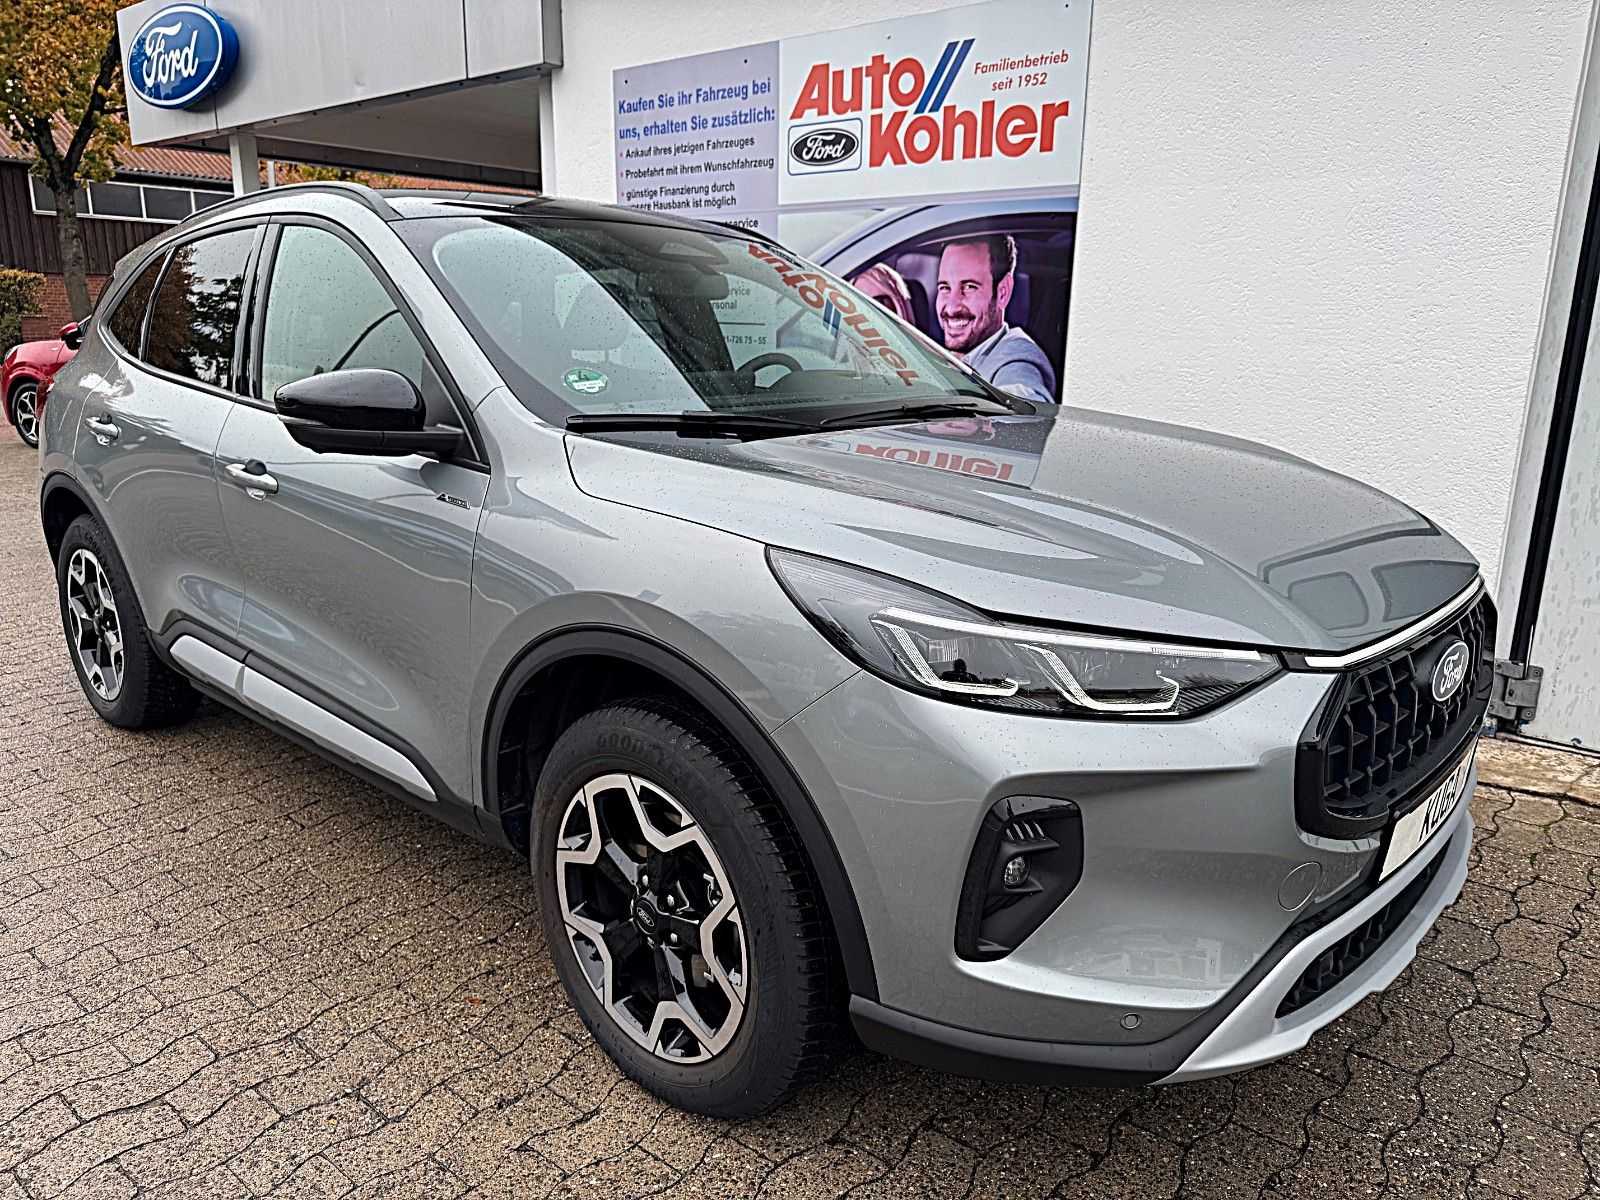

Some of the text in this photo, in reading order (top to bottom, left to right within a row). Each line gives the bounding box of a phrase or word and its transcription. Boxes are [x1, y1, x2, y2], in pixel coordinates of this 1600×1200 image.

[143, 21, 199, 88] Ford
[974, 49, 1069, 75] Familienbetrieb
[618, 77, 771, 114] Kaufen Sie ihr Fahrzeug bei
[790, 54, 926, 121] Auto
[992, 72, 1048, 91] seit 1952
[619, 105, 776, 141] uns, erhalten Sie zusätzlich:
[625, 136, 755, 159] Ankauf ihres jetzigen Fahrzeuges
[801, 133, 845, 161] Ford
[625, 157, 775, 180] Probefahrt mit ihrem Wunschfahrzeug
[626, 181, 735, 202] günstige Finanzierung durch
[653, 197, 690, 211] Hausbank
[692, 197, 702, 208] ist
[704, 195, 737, 210] möglich
[1439, 651, 1465, 694] Ford
[1418, 765, 1462, 842] KUGA
